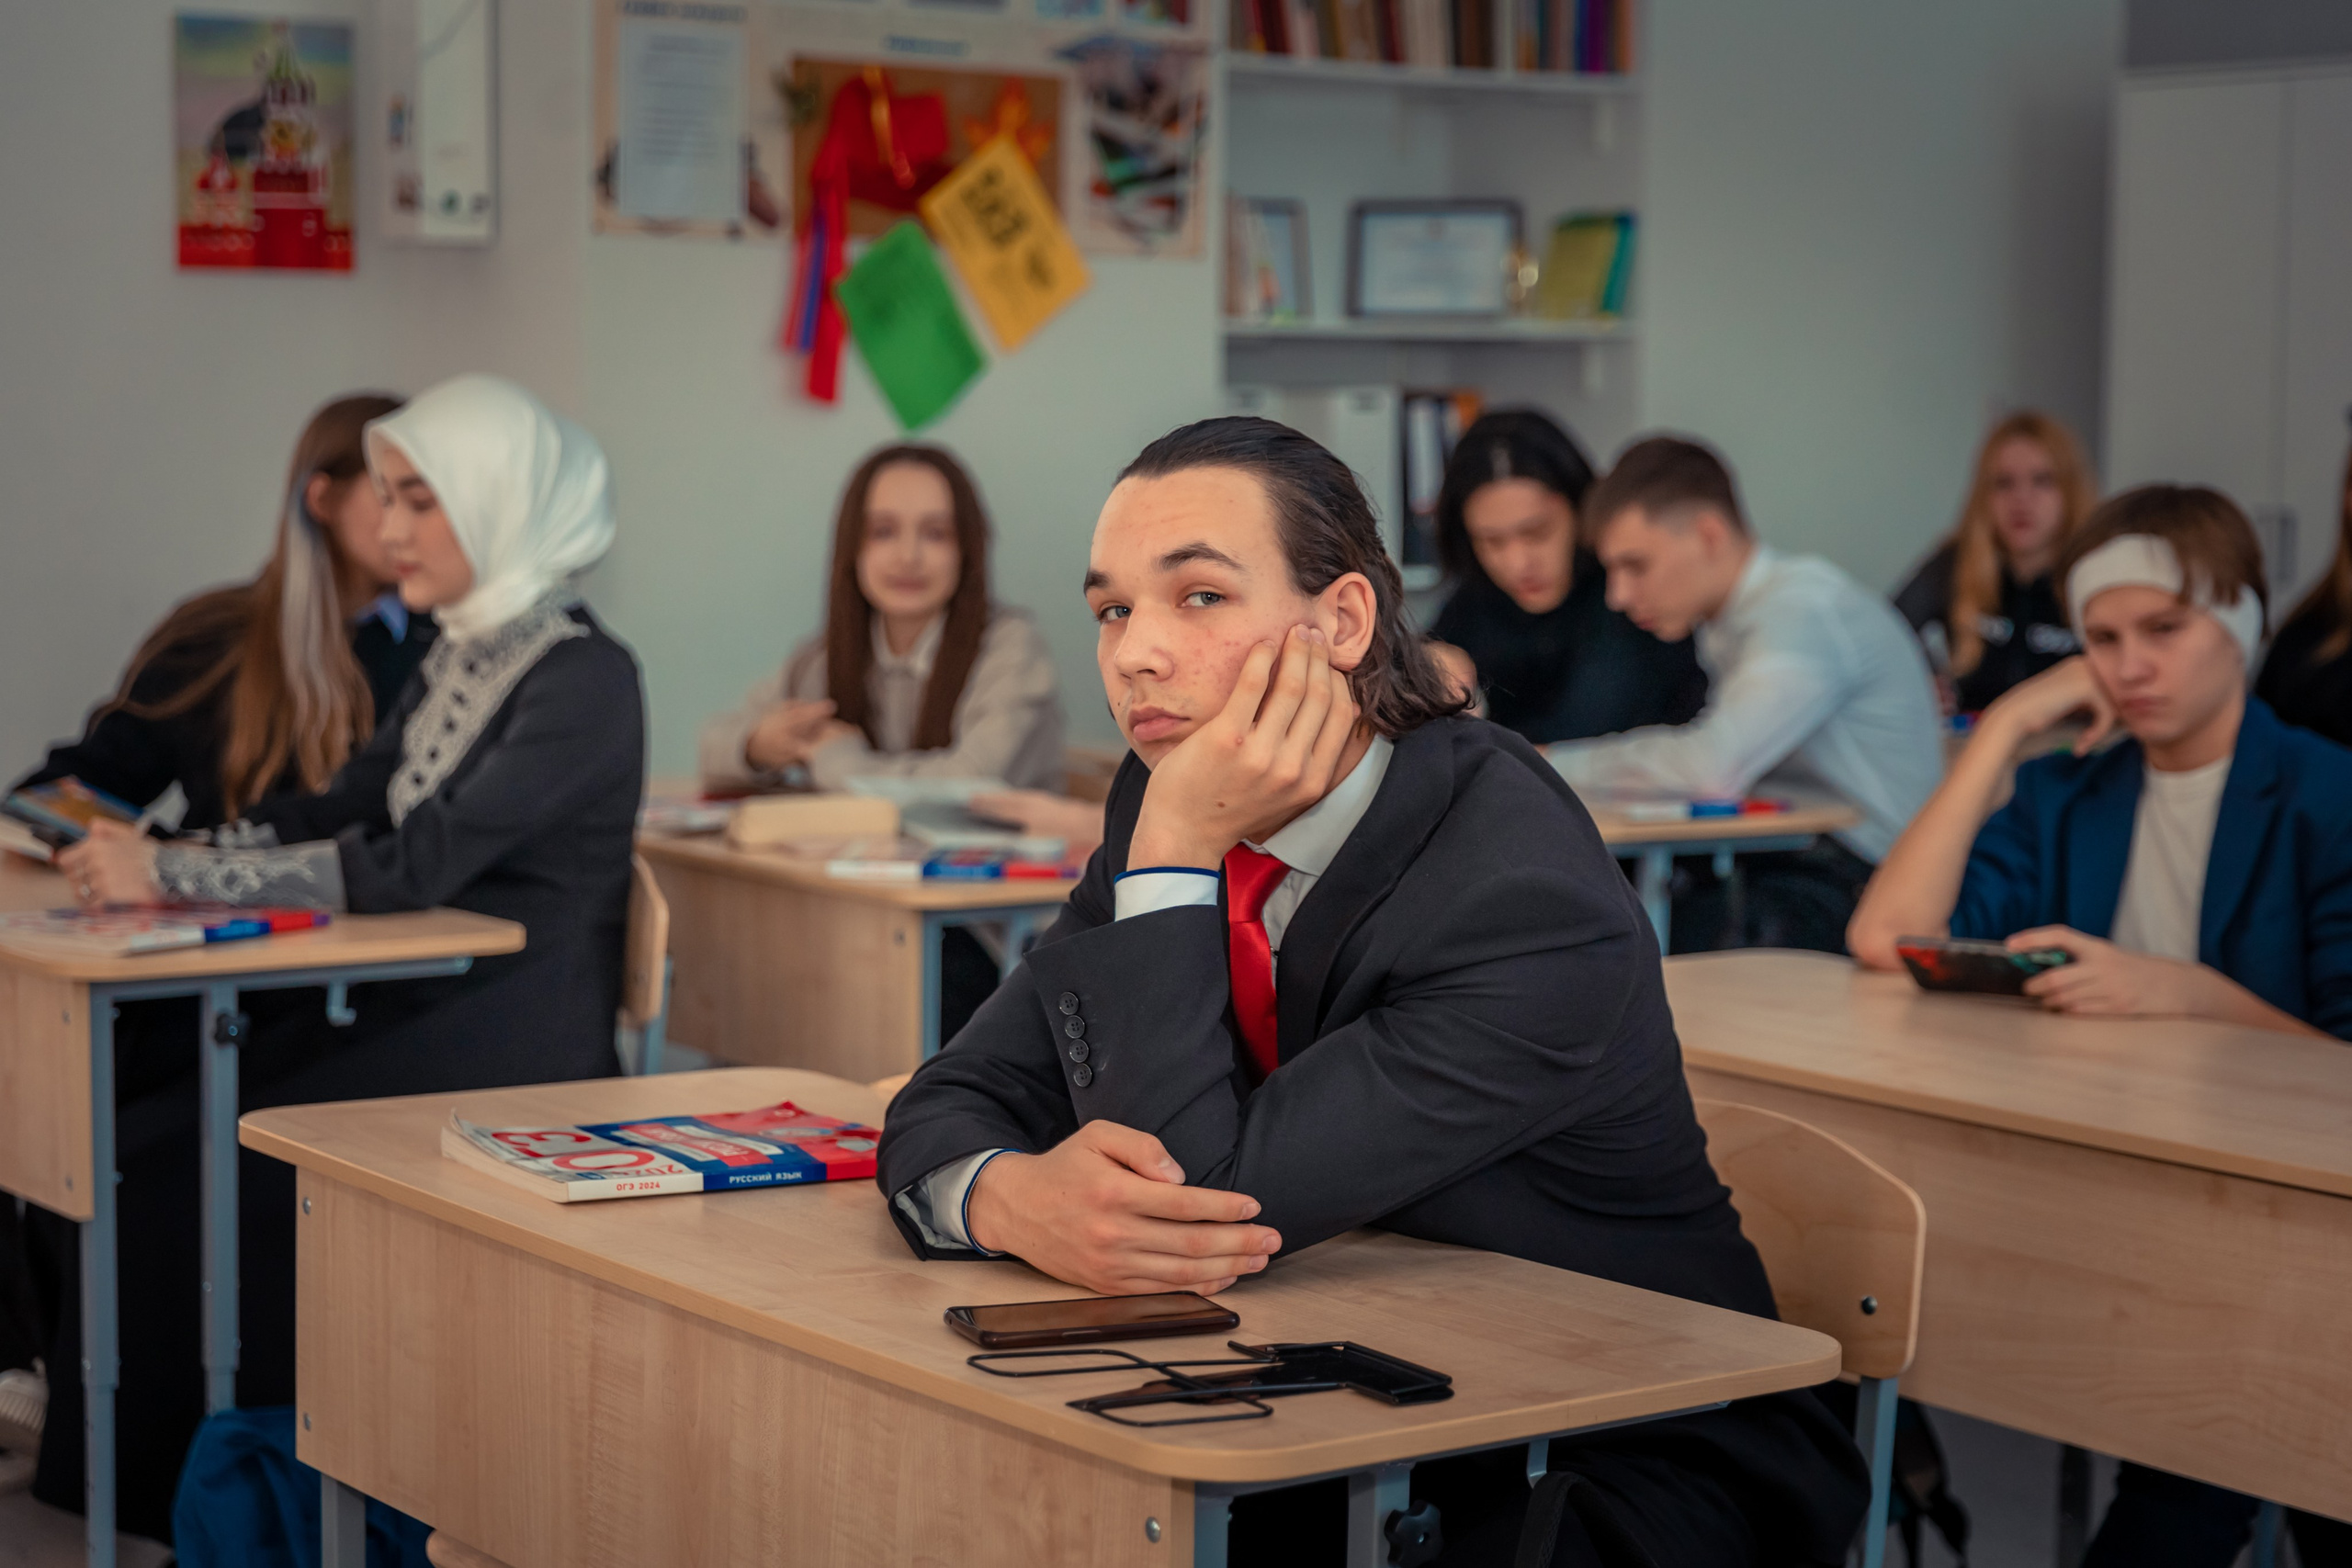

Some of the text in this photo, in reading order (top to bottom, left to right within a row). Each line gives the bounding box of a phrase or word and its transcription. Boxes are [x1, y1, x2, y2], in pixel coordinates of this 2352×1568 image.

[729, 1171, 803, 1184] РУССКИЙ ЯЗЫК
[616, 1181, 661, 1191] ОГЭ 2024
